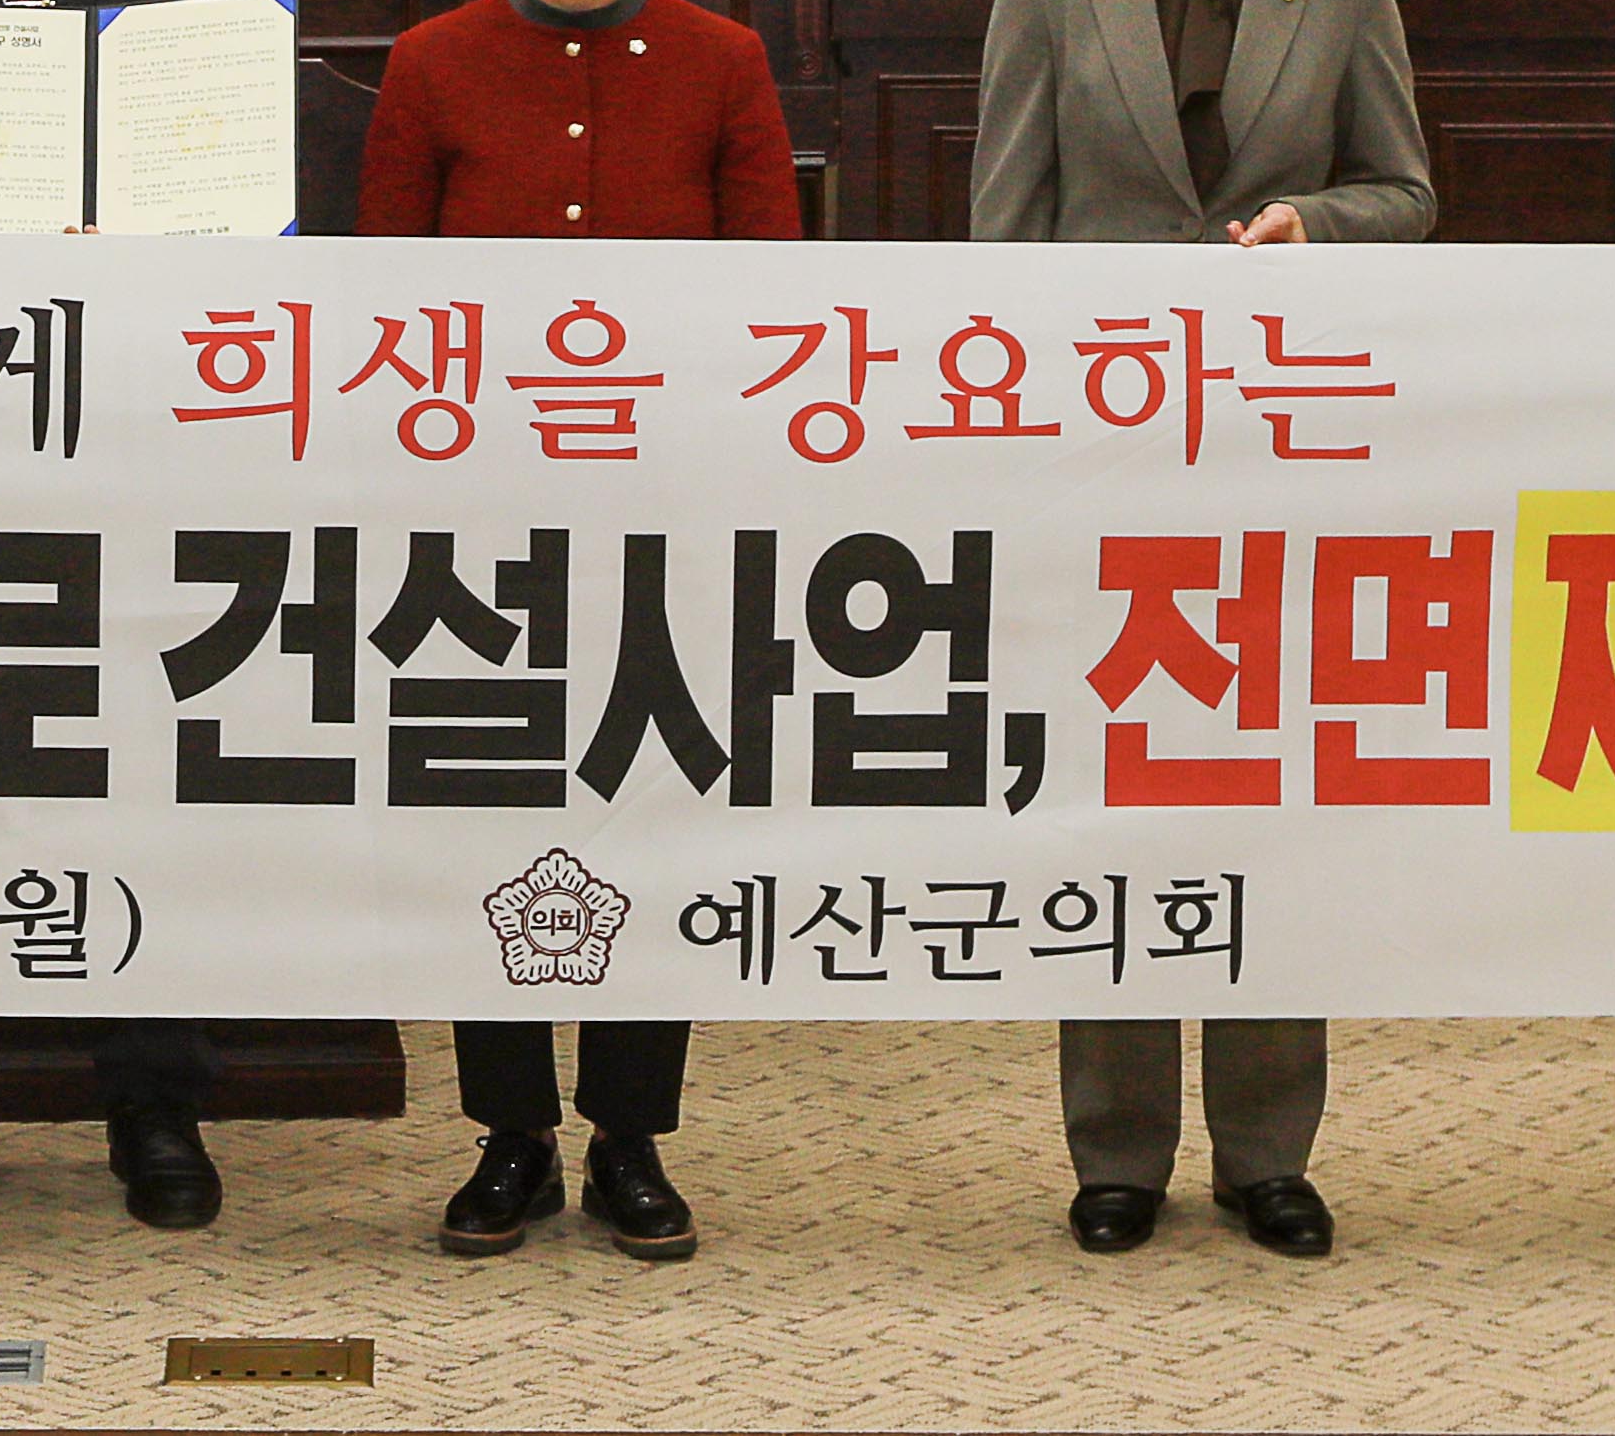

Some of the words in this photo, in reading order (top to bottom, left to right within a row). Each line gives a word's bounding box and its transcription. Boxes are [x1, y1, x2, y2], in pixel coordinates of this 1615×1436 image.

[171, 300, 665, 463] 희생을
[740, 305, 1397, 467] 강요하는
[158, 527, 1047, 817] 건설사업,
[1084, 529, 1496, 809] 전면
[530, 908, 581, 937] 의회
[677, 873, 1246, 987] 예산군의회
